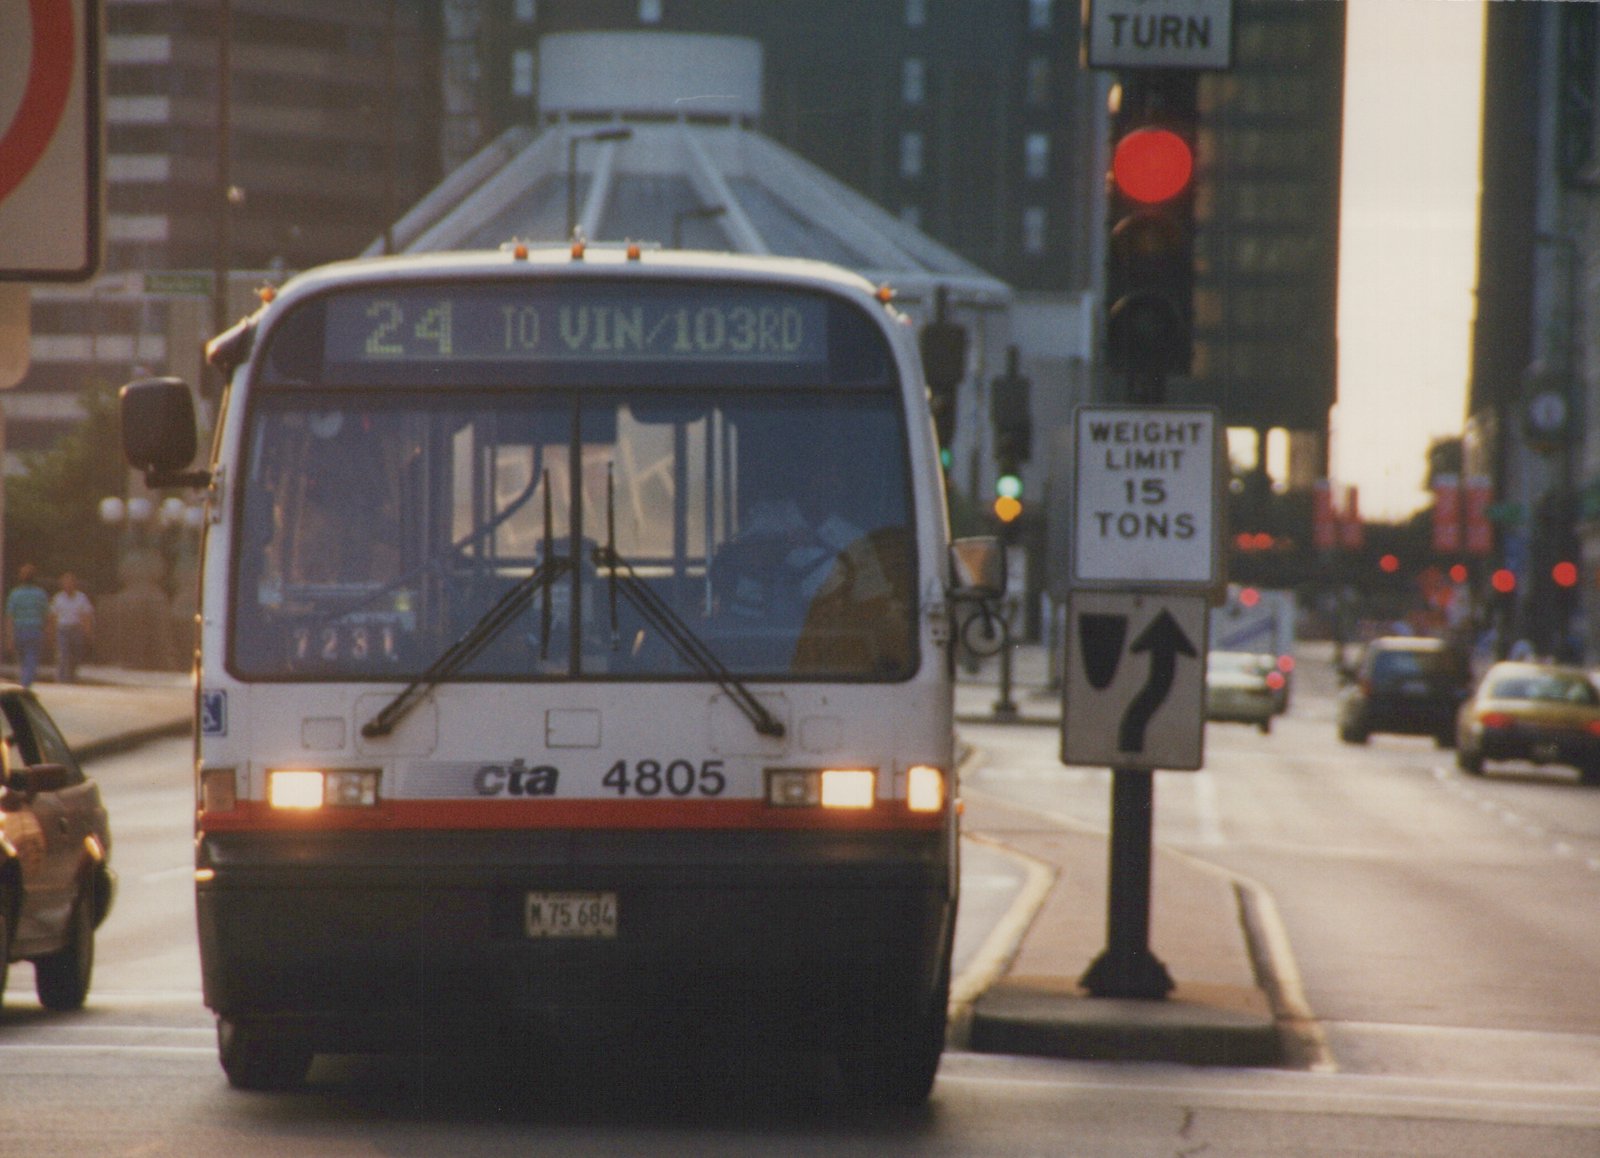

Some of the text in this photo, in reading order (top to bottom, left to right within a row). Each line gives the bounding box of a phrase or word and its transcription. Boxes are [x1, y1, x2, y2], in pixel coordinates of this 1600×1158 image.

[1107, 12, 1211, 49] TURN
[365, 300, 803, 354] 24 TO VIN/103RD
[1088, 421, 1203, 444] WEIGHT
[1105, 448, 1184, 470] LIMIT
[1125, 478, 1168, 505] 15
[1094, 511, 1196, 539] TONS
[473, 758, 726, 797] cta 4805
